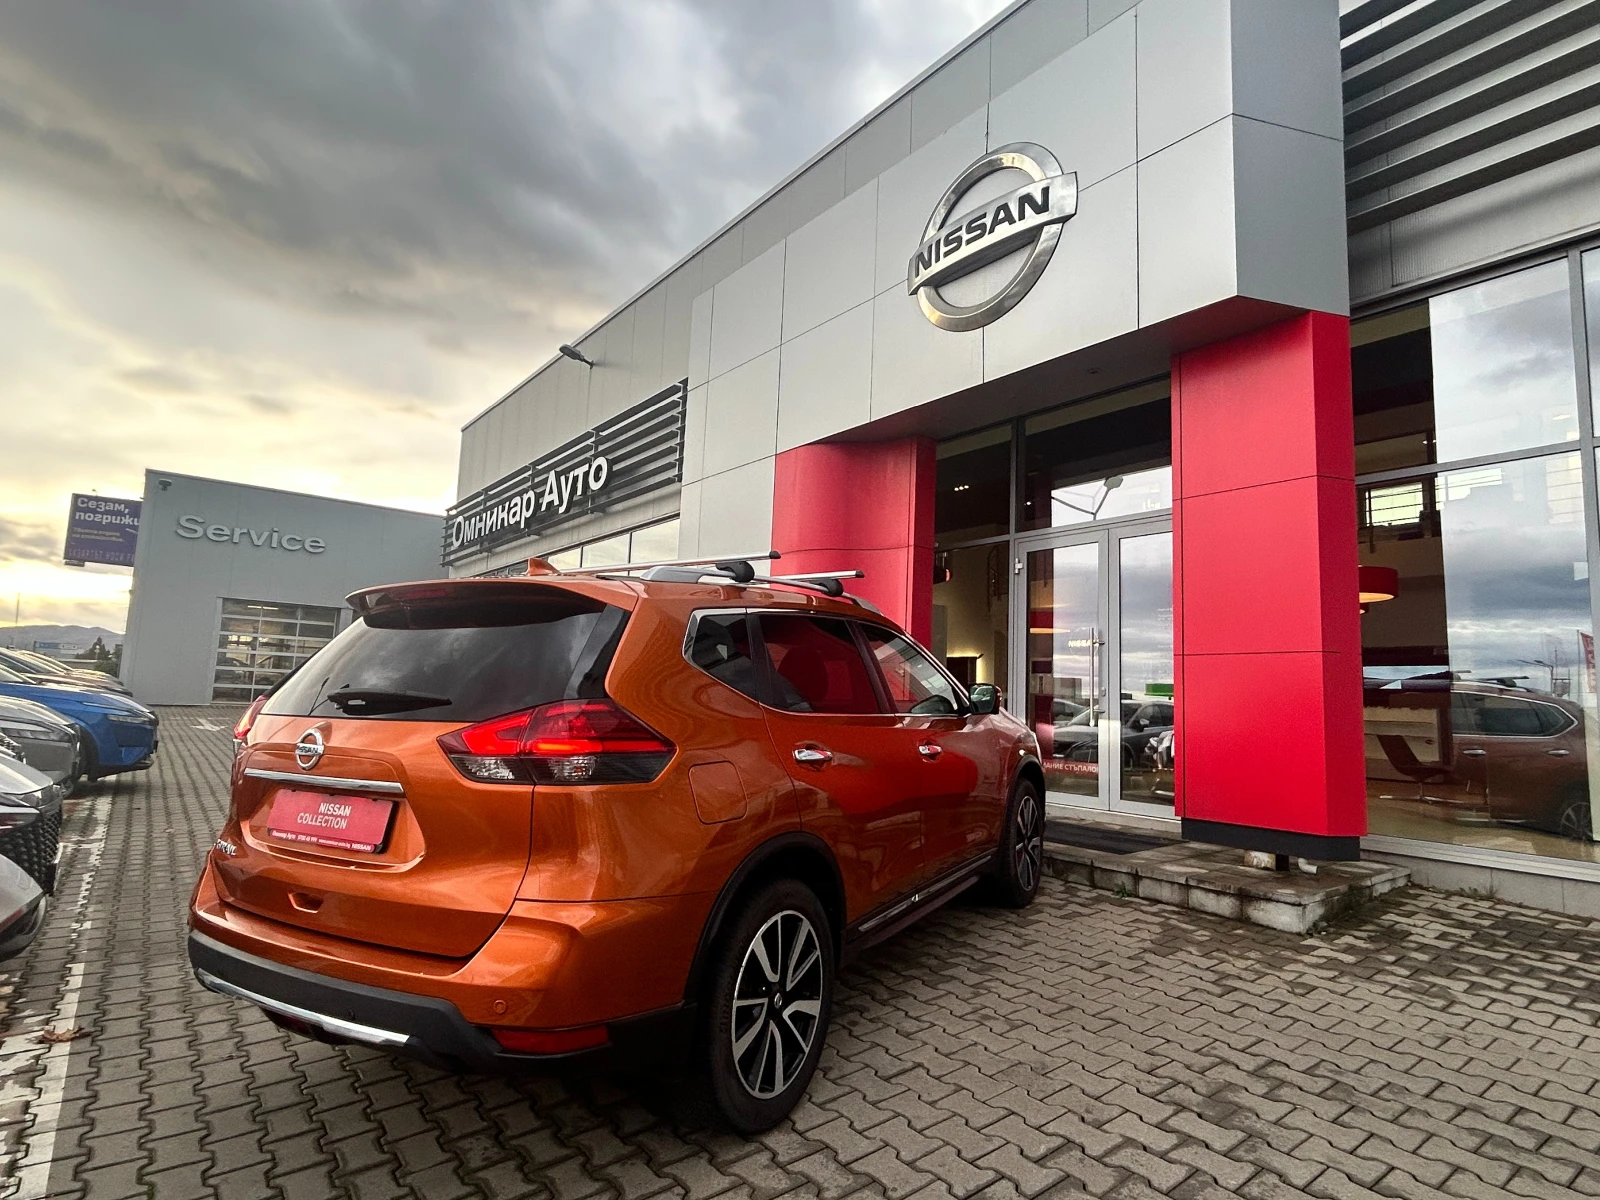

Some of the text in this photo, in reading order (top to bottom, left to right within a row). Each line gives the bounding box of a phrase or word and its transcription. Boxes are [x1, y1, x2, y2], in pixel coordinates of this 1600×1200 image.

[914, 186, 1050, 278] NISSAN
[77, 497, 129, 514] Сезам,
[452, 456, 608, 547] Омникар Ауто
[175, 514, 326, 553] Service
[297, 812, 348, 829] COLLECTION
[318, 802, 352, 816] NISSAN
